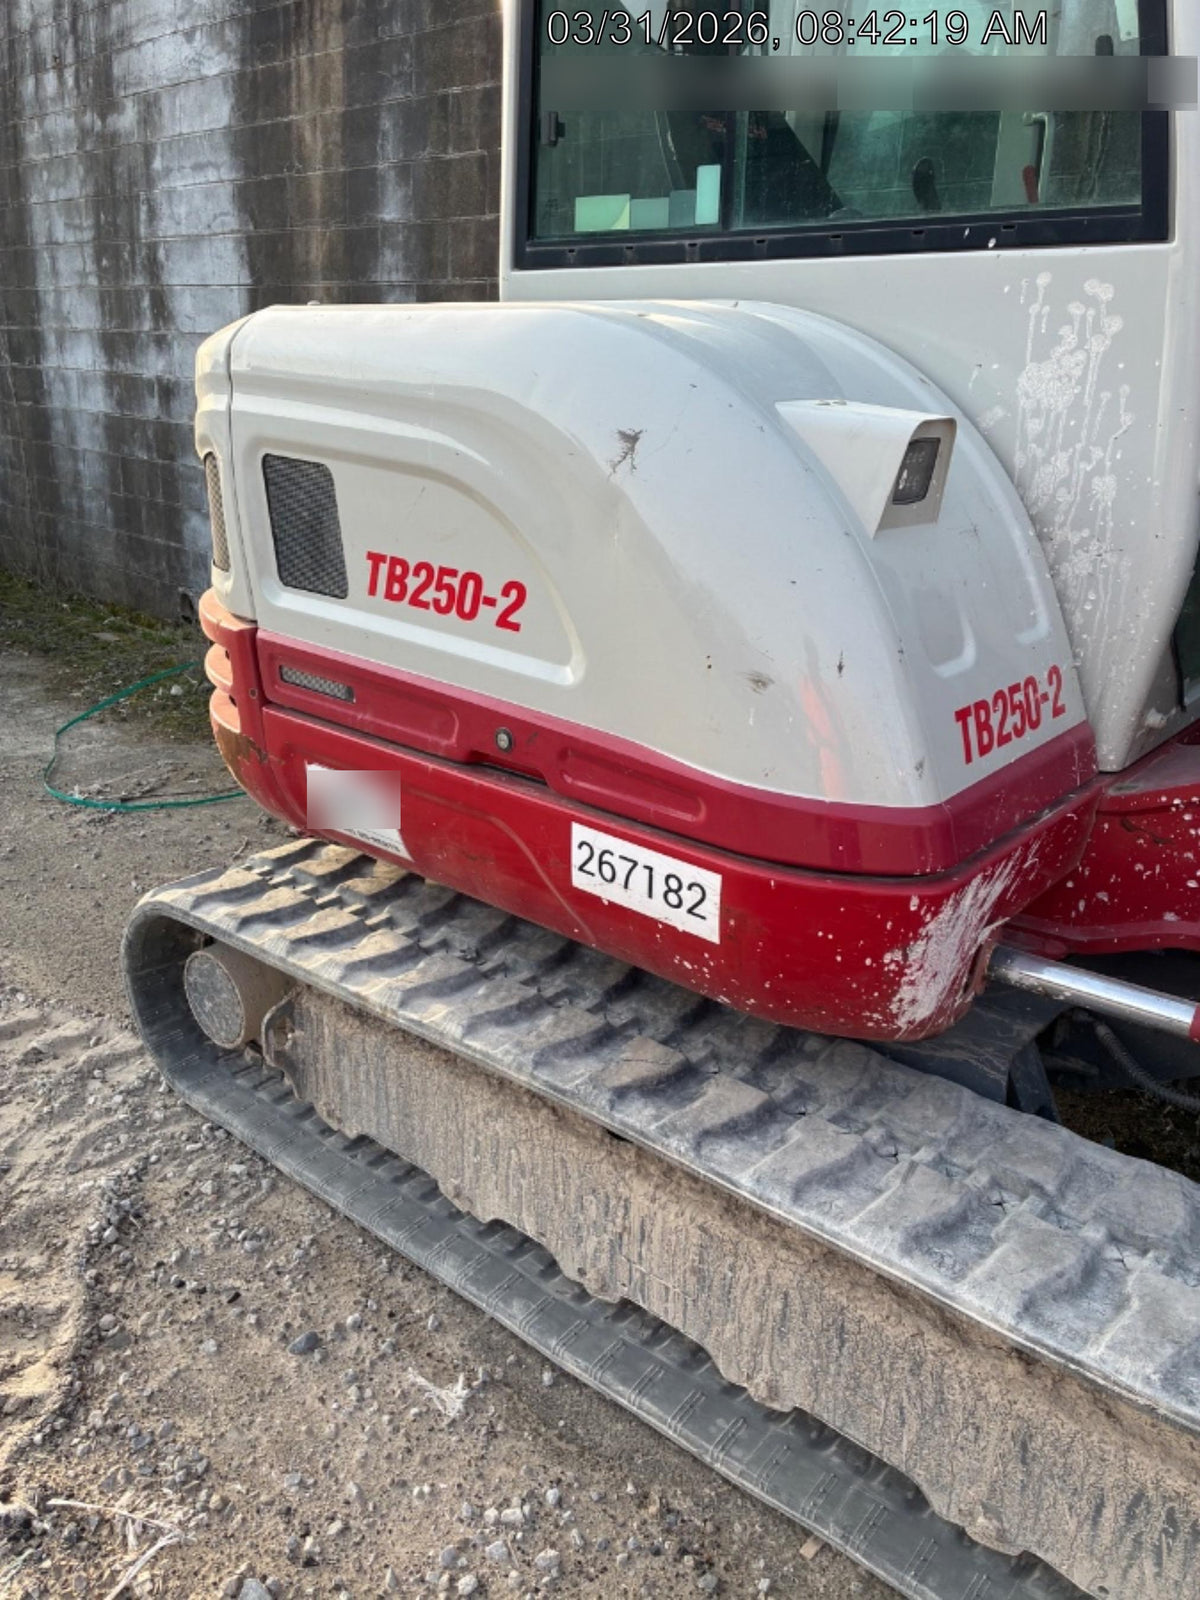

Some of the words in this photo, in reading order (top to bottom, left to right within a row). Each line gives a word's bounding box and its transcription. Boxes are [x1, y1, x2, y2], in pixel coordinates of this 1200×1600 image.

[366, 551, 527, 632] TB250-2
[954, 664, 1066, 765] TB250-2
[576, 840, 708, 920] 267182
